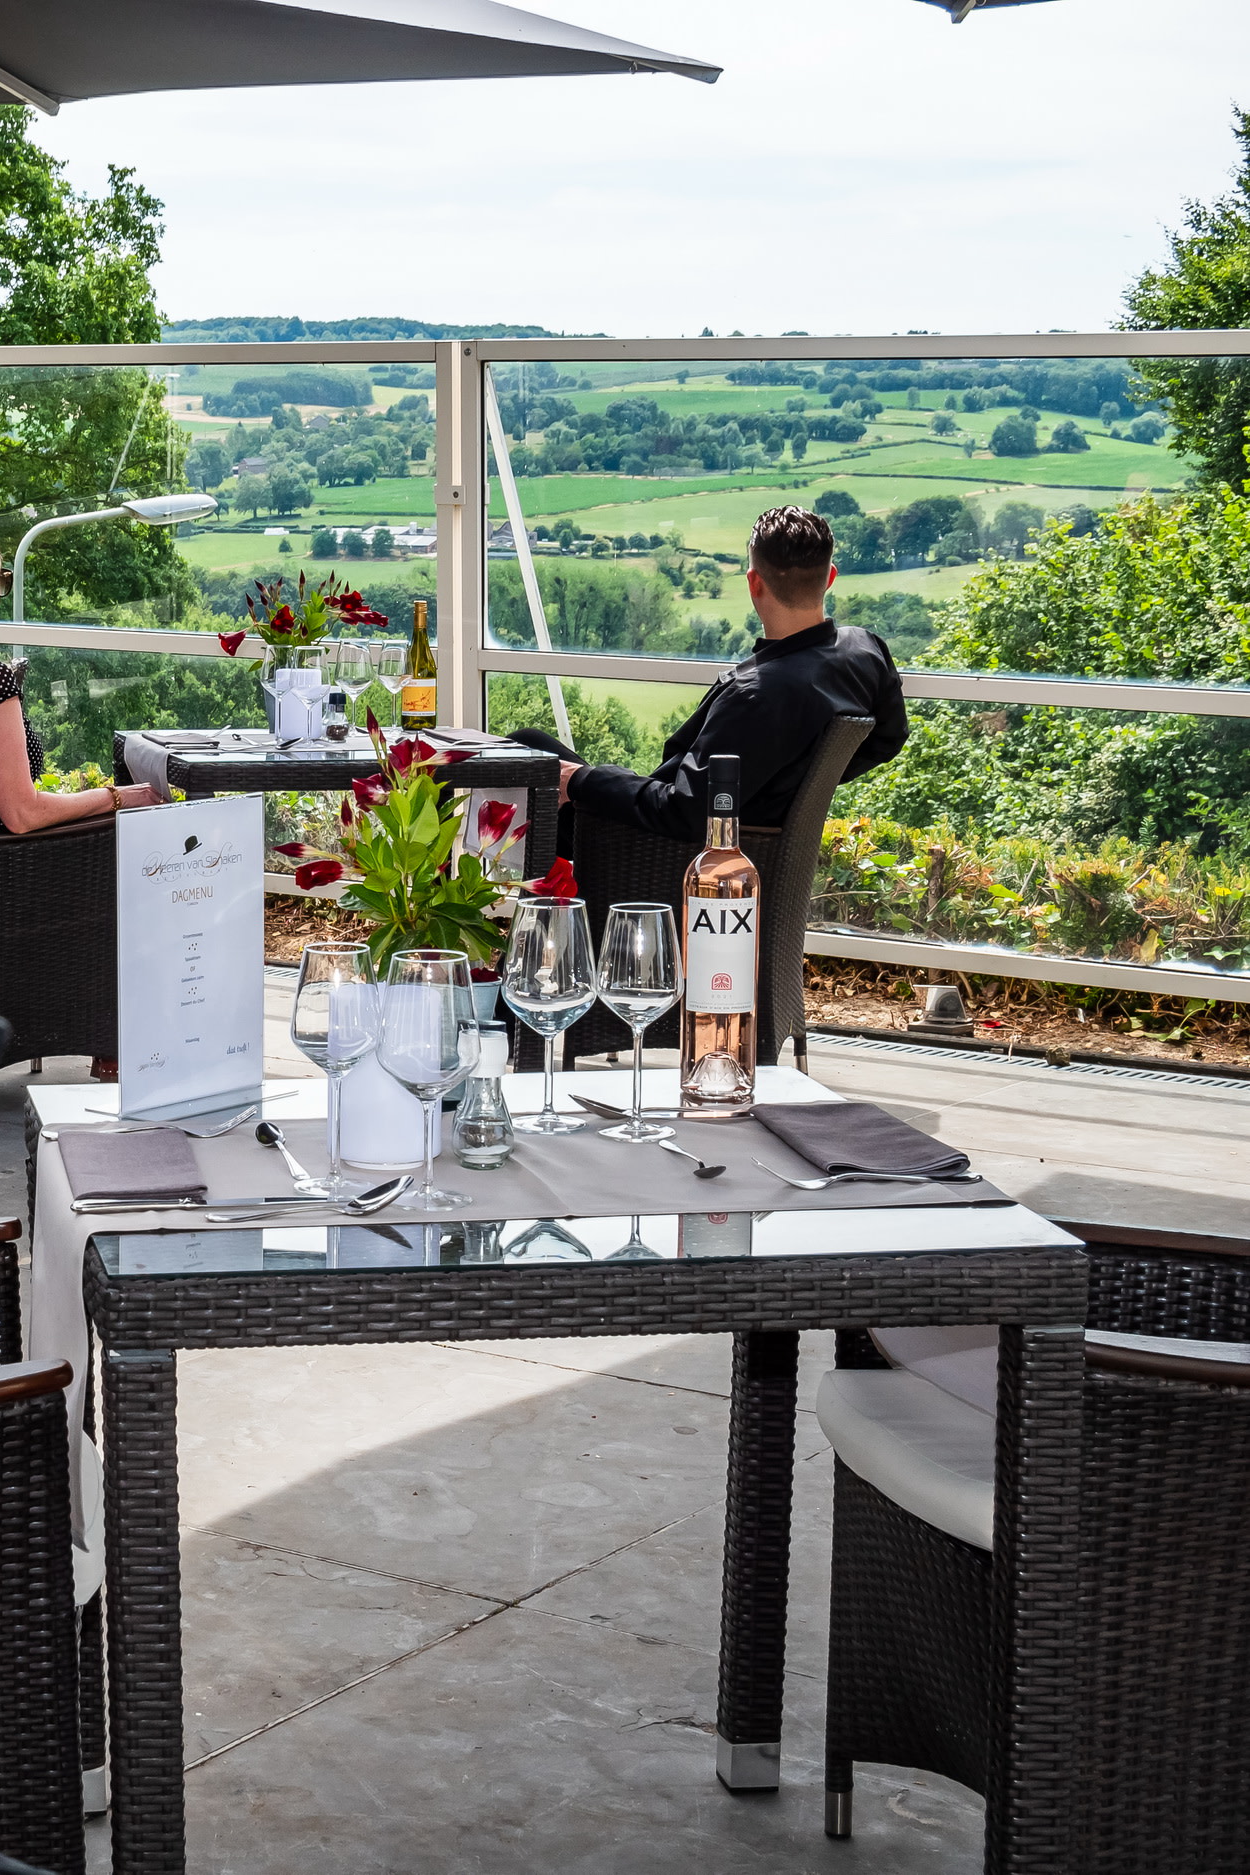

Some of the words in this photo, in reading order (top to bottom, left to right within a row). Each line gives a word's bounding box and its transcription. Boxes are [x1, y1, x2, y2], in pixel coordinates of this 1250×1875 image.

[186, 858, 203, 871] van
[171, 885, 214, 904] DAGMENU
[691, 907, 753, 935] AIX
